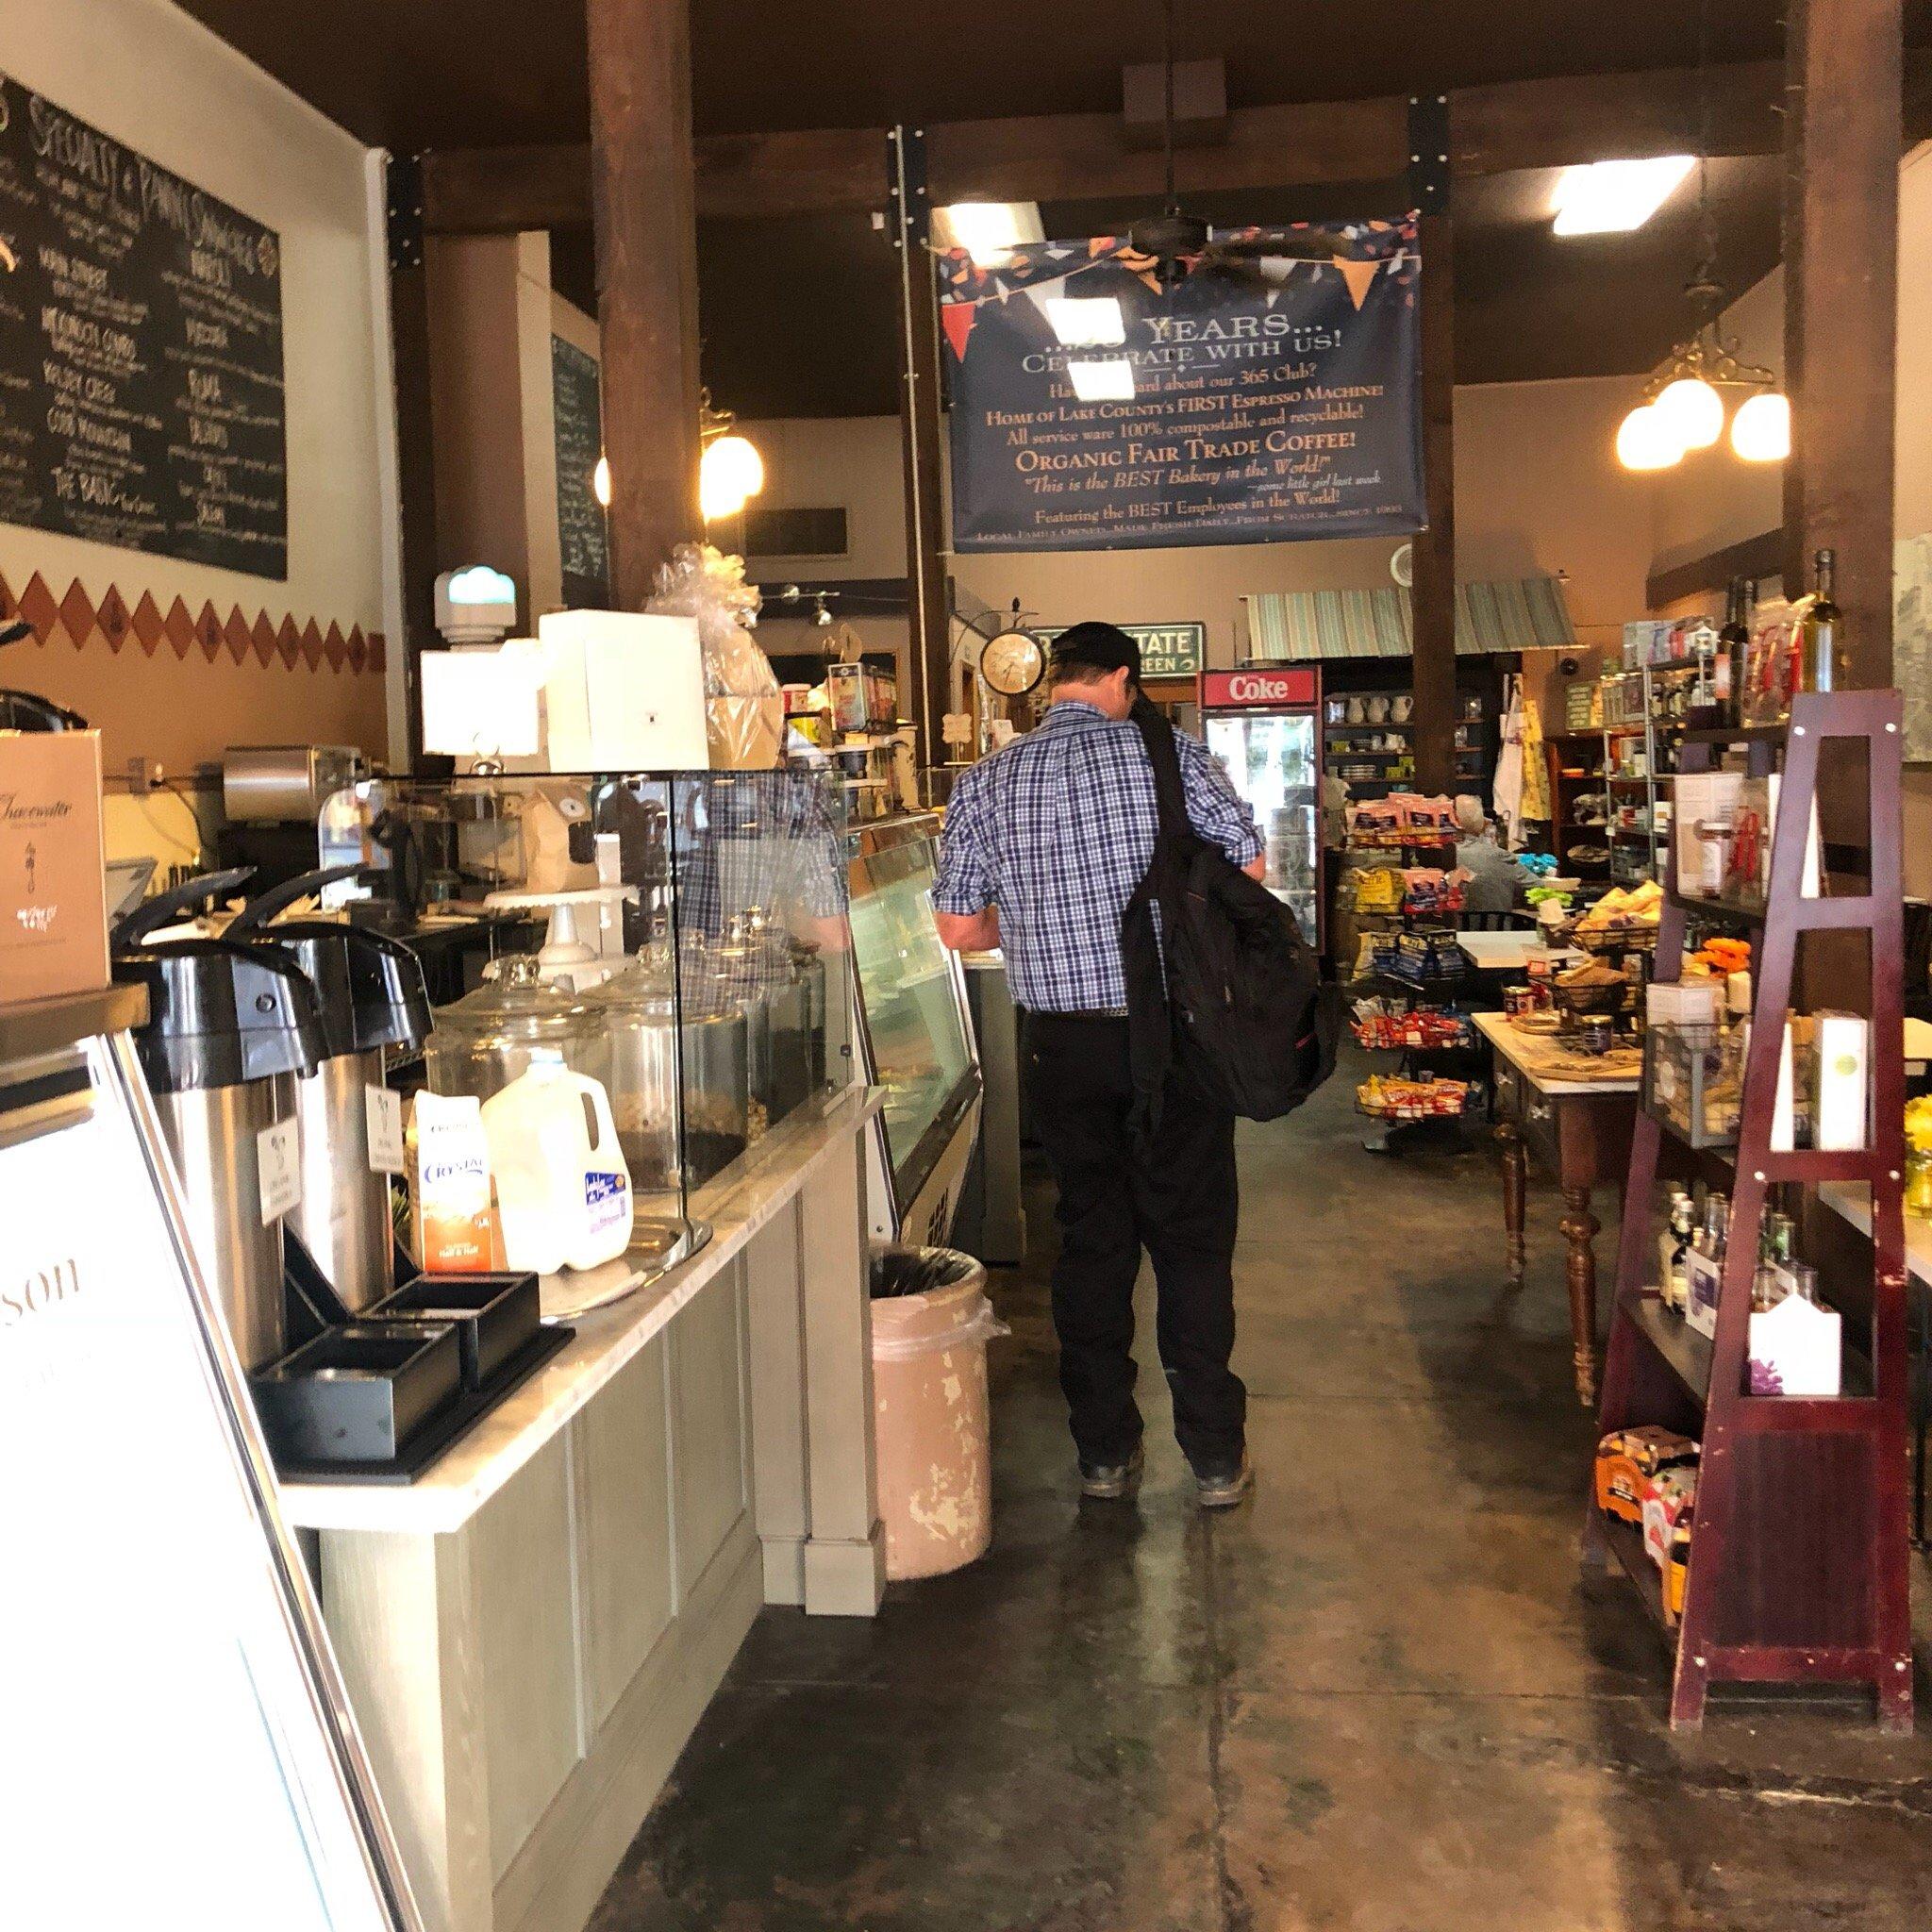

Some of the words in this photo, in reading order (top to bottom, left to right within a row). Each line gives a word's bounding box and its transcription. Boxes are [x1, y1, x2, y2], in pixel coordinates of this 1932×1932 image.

[1206, 341, 1281, 359] WITH
[1293, 329, 1341, 353] US!
[1165, 374, 1204, 391] about
[1209, 376, 1235, 388] our
[1241, 368, 1269, 385] 365
[1274, 362, 1318, 382] Club?
[986, 410, 1034, 425] HOME
[1036, 411, 1055, 422] OF
[1058, 407, 1096, 422] LAKE
[1099, 402, 1174, 419] COUNTY'S
[1177, 394, 1228, 413] FIRST
[1231, 391, 1302, 408] ESPRESSO
[1008, 427, 1028, 445] All
[1032, 430, 1078, 444] service
[1082, 429, 1115, 441] ware
[1121, 424, 1163, 439] 100%
[1167, 411, 1255, 436] compostable
[1259, 408, 1286, 426] and
[1015, 449, 1123, 472] ORGANIC
[1127, 442, 1180, 464] FAIR
[1184, 439, 1261, 459] TRADE
[1265, 430, 1357, 453] COFFEE!
[1069, 477, 1082, 491] is
[1085, 473, 1109, 491] the
[1113, 469, 1165, 489] BEST
[1168, 464, 1222, 486] Bakery
[1224, 466, 1241, 480] in
[1244, 459, 1269, 477] the
[1035, 509, 1100, 525] Featuring
[1103, 504, 1124, 520] the
[1128, 501, 1173, 518] BEST
[1176, 496, 1247, 518] Employees
[1252, 496, 1265, 509] in
[1269, 492, 1291, 508] the
[1133, 631, 1192, 655] TATE
[1229, 675, 1289, 701] Coke
